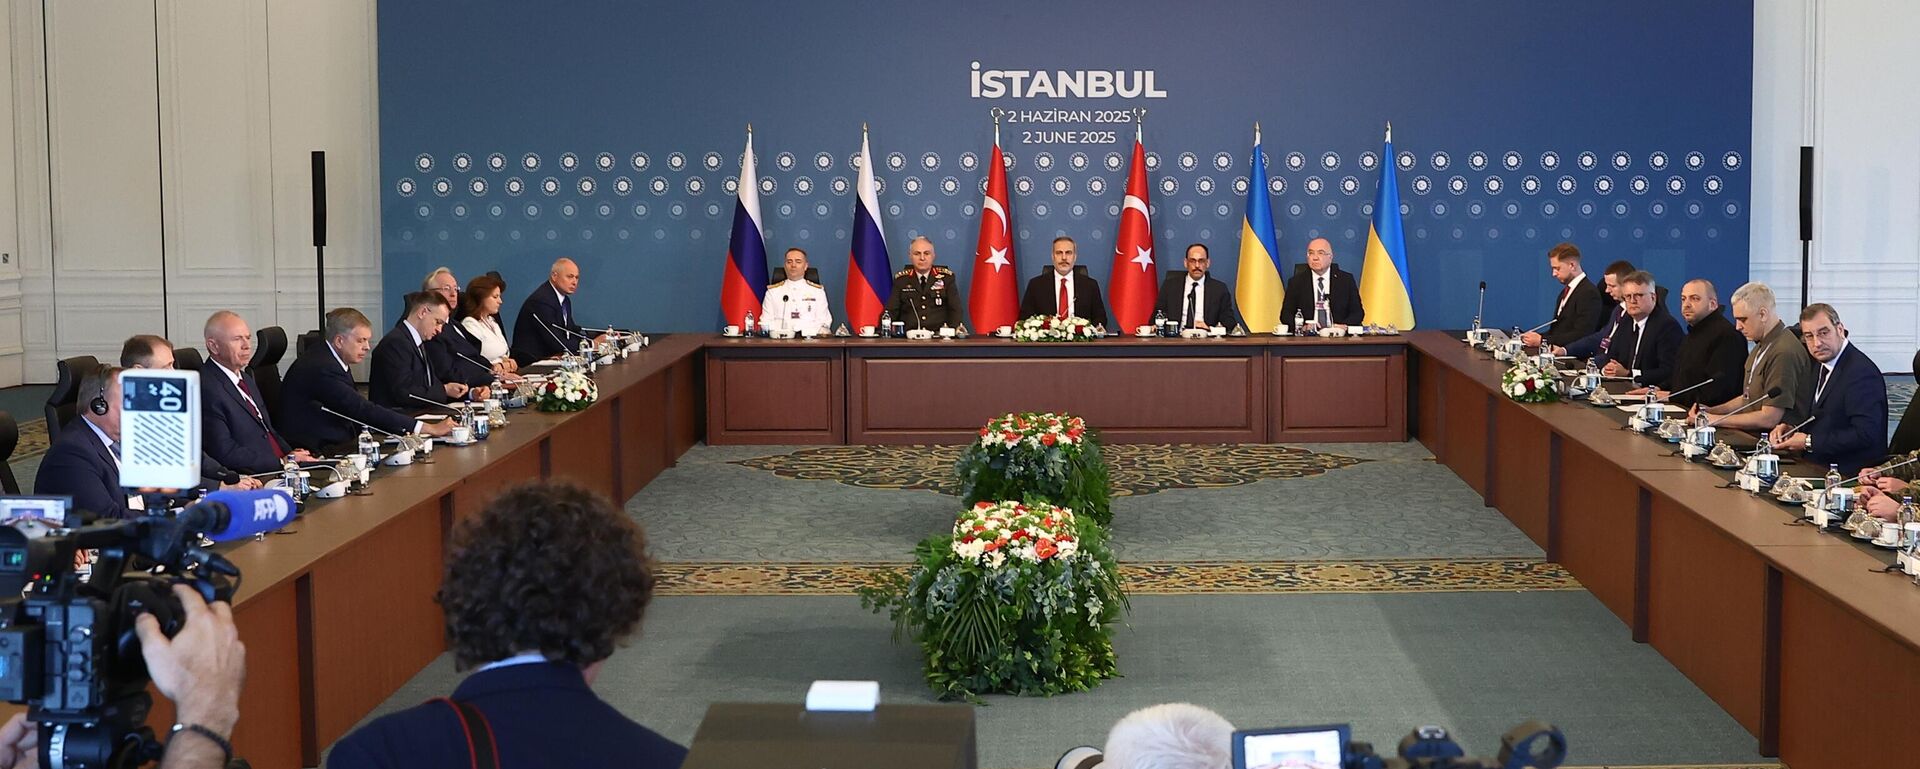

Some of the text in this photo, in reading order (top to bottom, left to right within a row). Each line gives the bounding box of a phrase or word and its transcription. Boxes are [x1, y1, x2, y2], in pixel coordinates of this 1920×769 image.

[970, 61, 1167, 98] İSTANBUL
[1007, 108, 1131, 123] 2 HAZİRAN 2025
[1022, 131, 1116, 144] 2 JUNE 2025
[159, 381, 182, 411] 40
